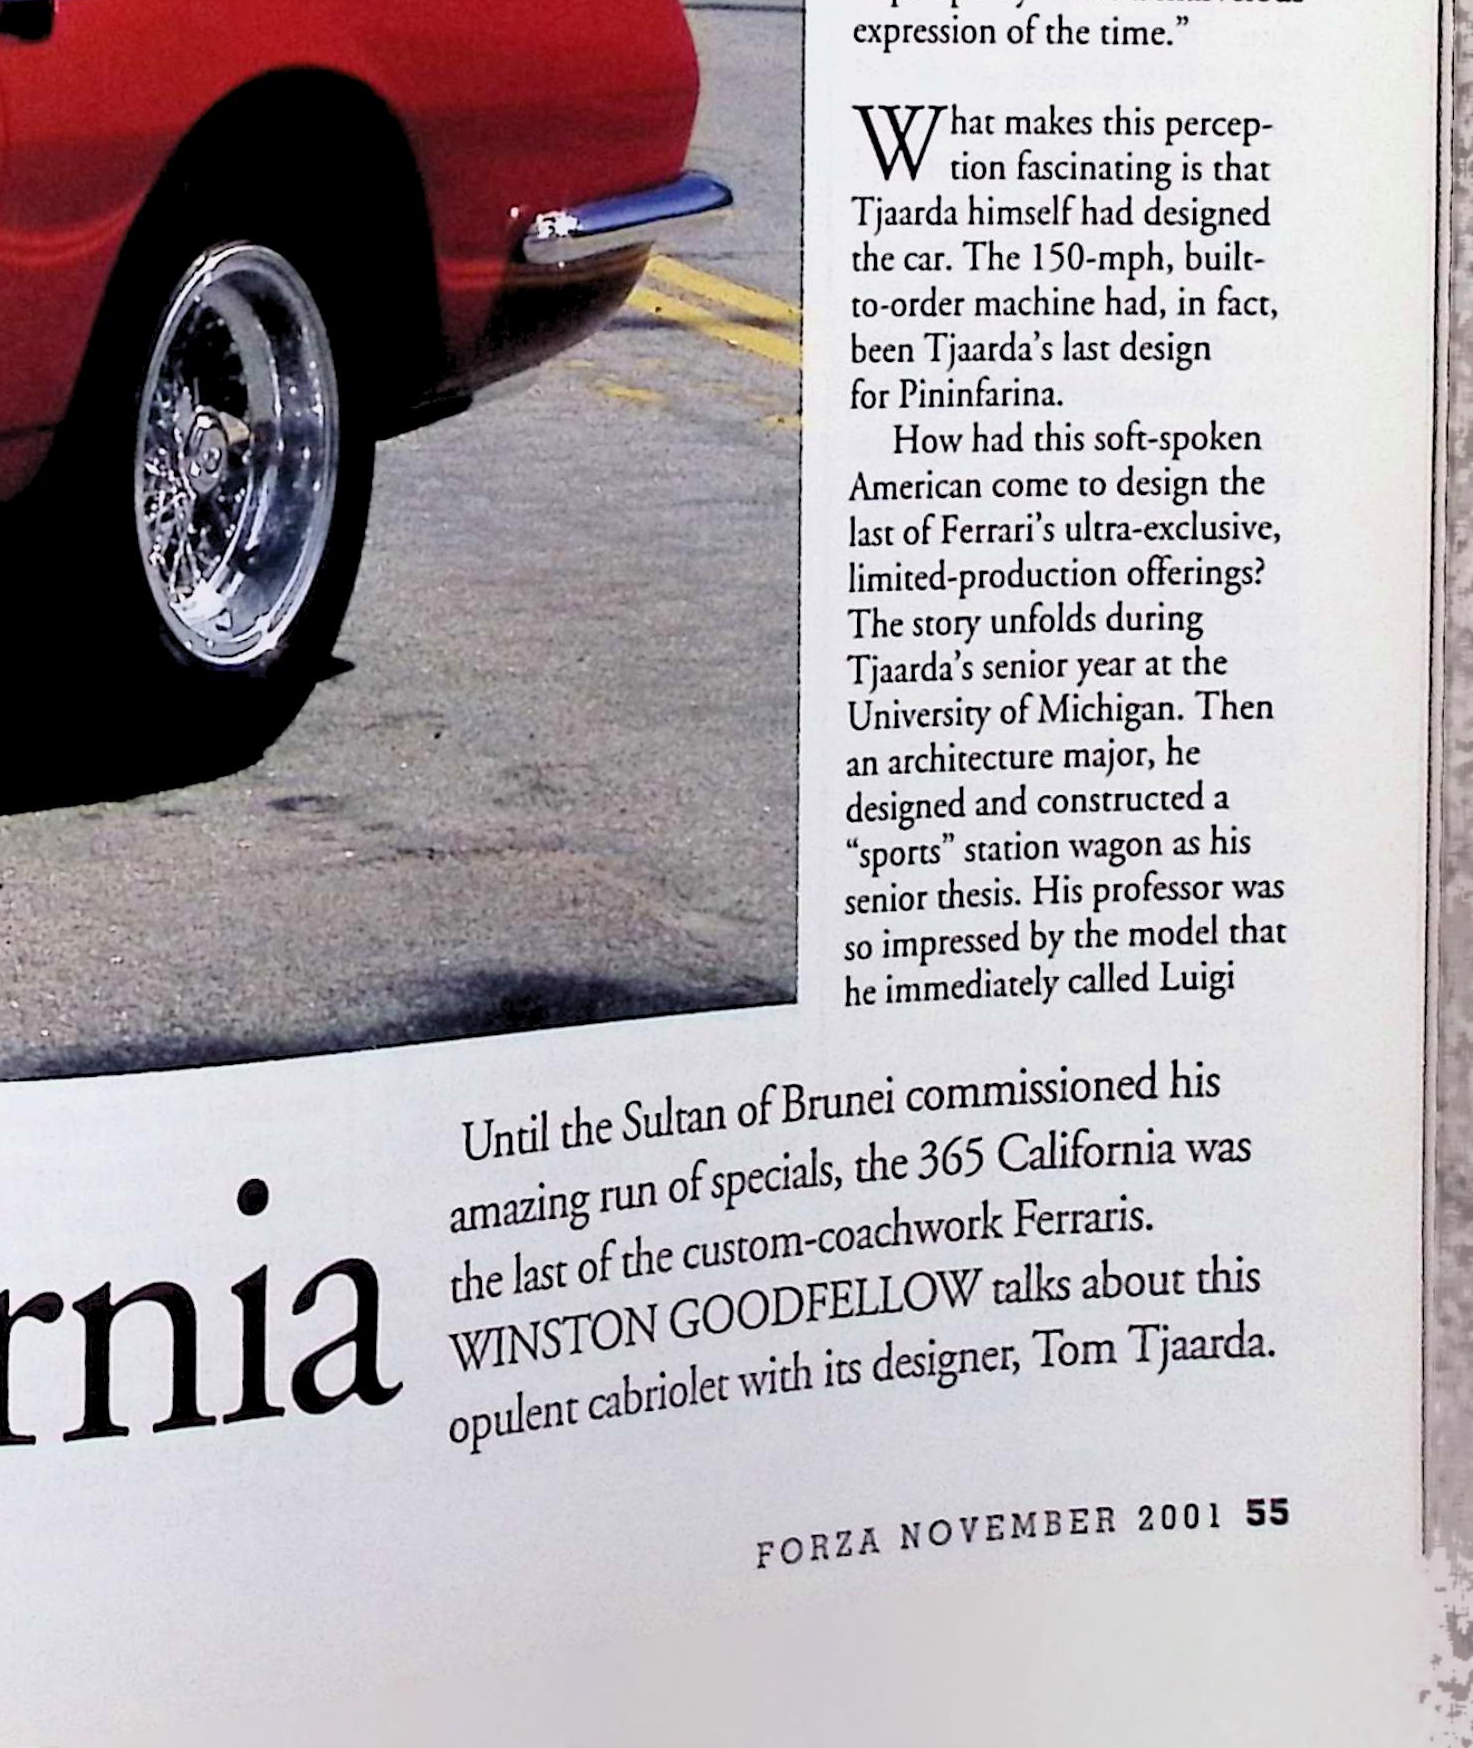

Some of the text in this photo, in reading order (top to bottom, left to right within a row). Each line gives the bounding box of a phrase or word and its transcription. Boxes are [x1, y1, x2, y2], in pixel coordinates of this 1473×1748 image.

[854, 15, 996, 53] expression
[1007, 13, 1040, 44] of
[1046, 14, 1089, 44] the
[1005, 104, 1092, 135] makes
[1104, 105, 1154, 135] this
[1166, 117, 1272, 147] percep-
[852, 240, 1264, 281] the car. The 150-mph, built-
[851, 332, 914, 363] been
[1063, 330, 1110, 361] last
[1120, 330, 1211, 371] design
[894, 419, 1261, 460] How had this soft-spoken
[849, 554, 1265, 599] limited-production offerings?
[847, 601, 1203, 644] The story unfolds during
[848, 689, 1273, 735] University of Michigan. Then
[846, 779, 1229, 831] designed and constructed a
[844, 913, 1287, 966] so impressed by the model that
[462, 1059, 1220, 1161] Until the Sultan of Brunei commissioned his
[450, 1128, 1251, 1233] amazing run of specials, the 365 California was
[451, 1194, 1153, 1303] the last of the custom-coachwork Ferraris.
[448, 1254, 1260, 1372] WINSTON GOODFELLOW talks about this
[450, 1318, 1275, 1455] opulent cabriolet with its designer, Tom Tjaarda.
[757, 1498, 1289, 1569] FORZA NOVEMBER 2001 55
